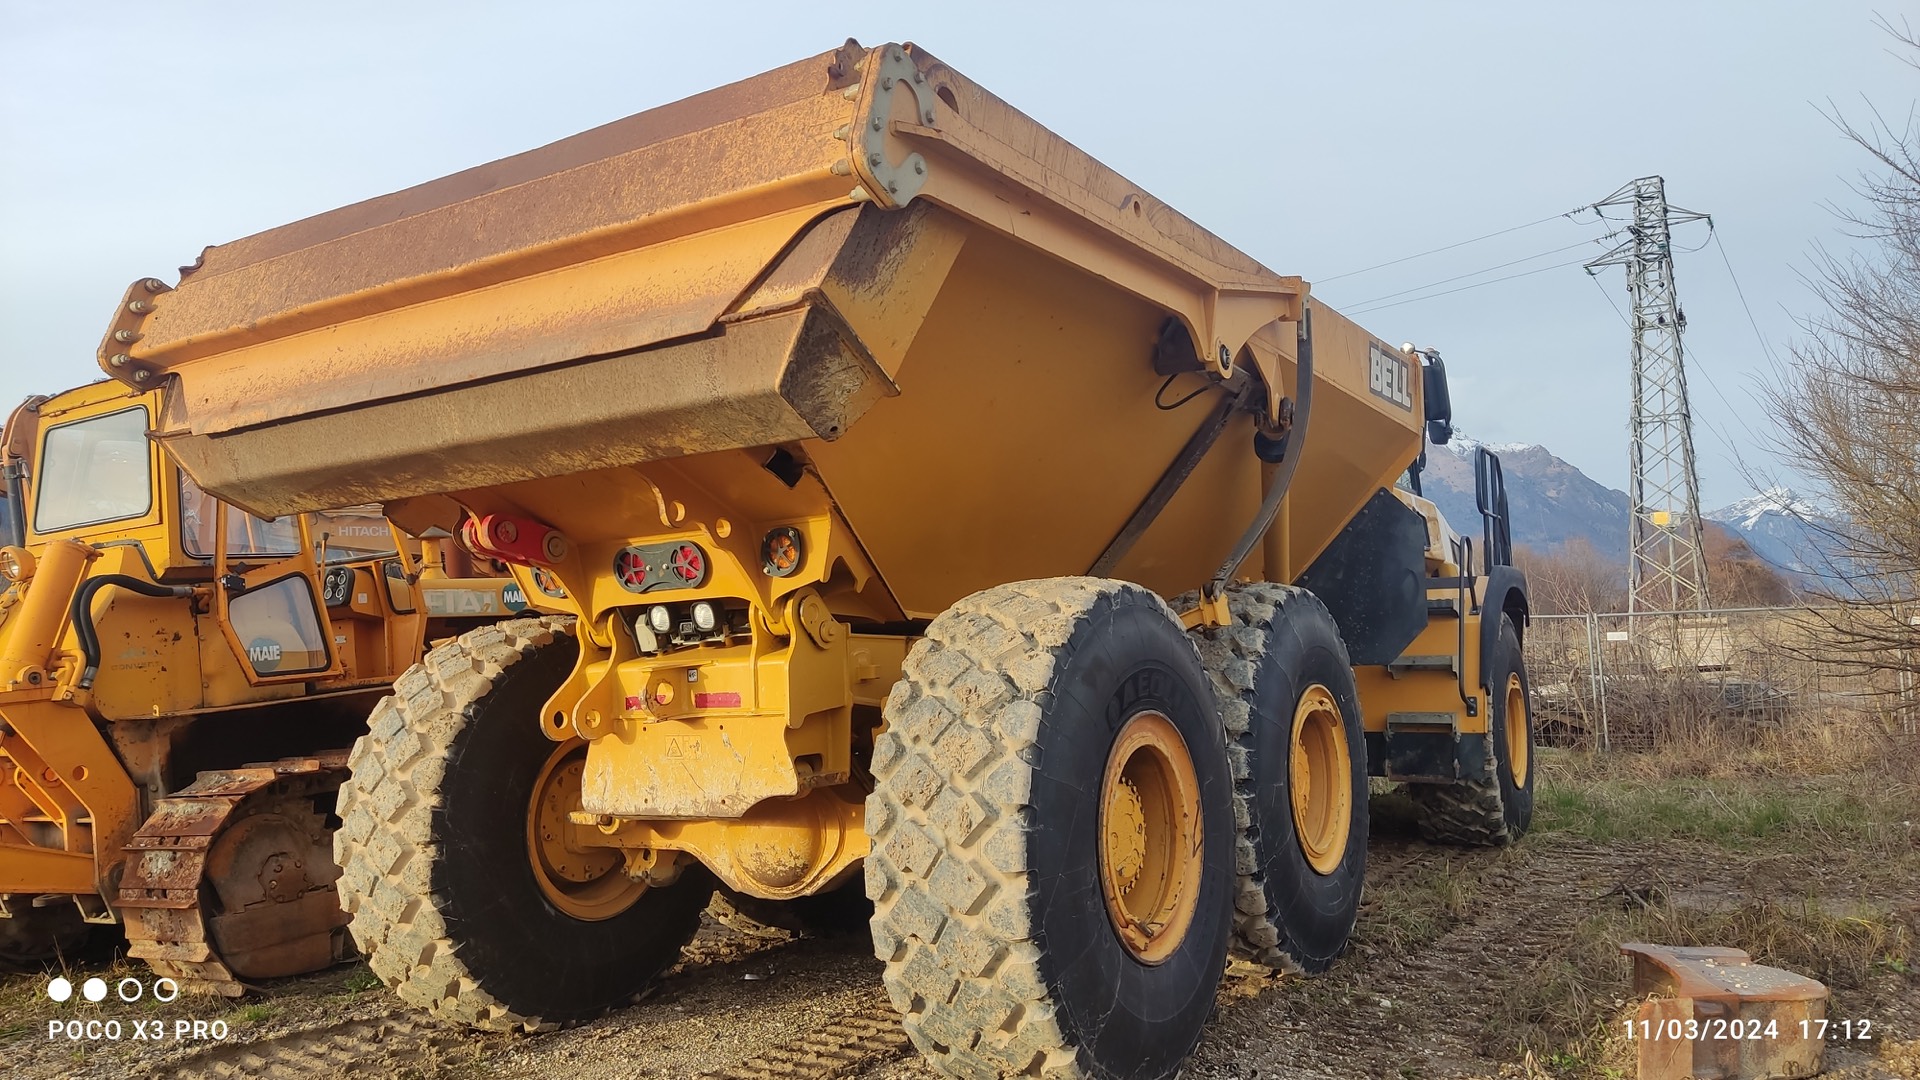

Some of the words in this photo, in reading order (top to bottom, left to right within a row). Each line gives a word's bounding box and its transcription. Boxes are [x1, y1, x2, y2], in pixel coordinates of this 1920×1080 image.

[1370, 346, 1411, 408] BELL
[423, 589, 494, 614] FIAT
[249, 644, 281, 662] MAIE
